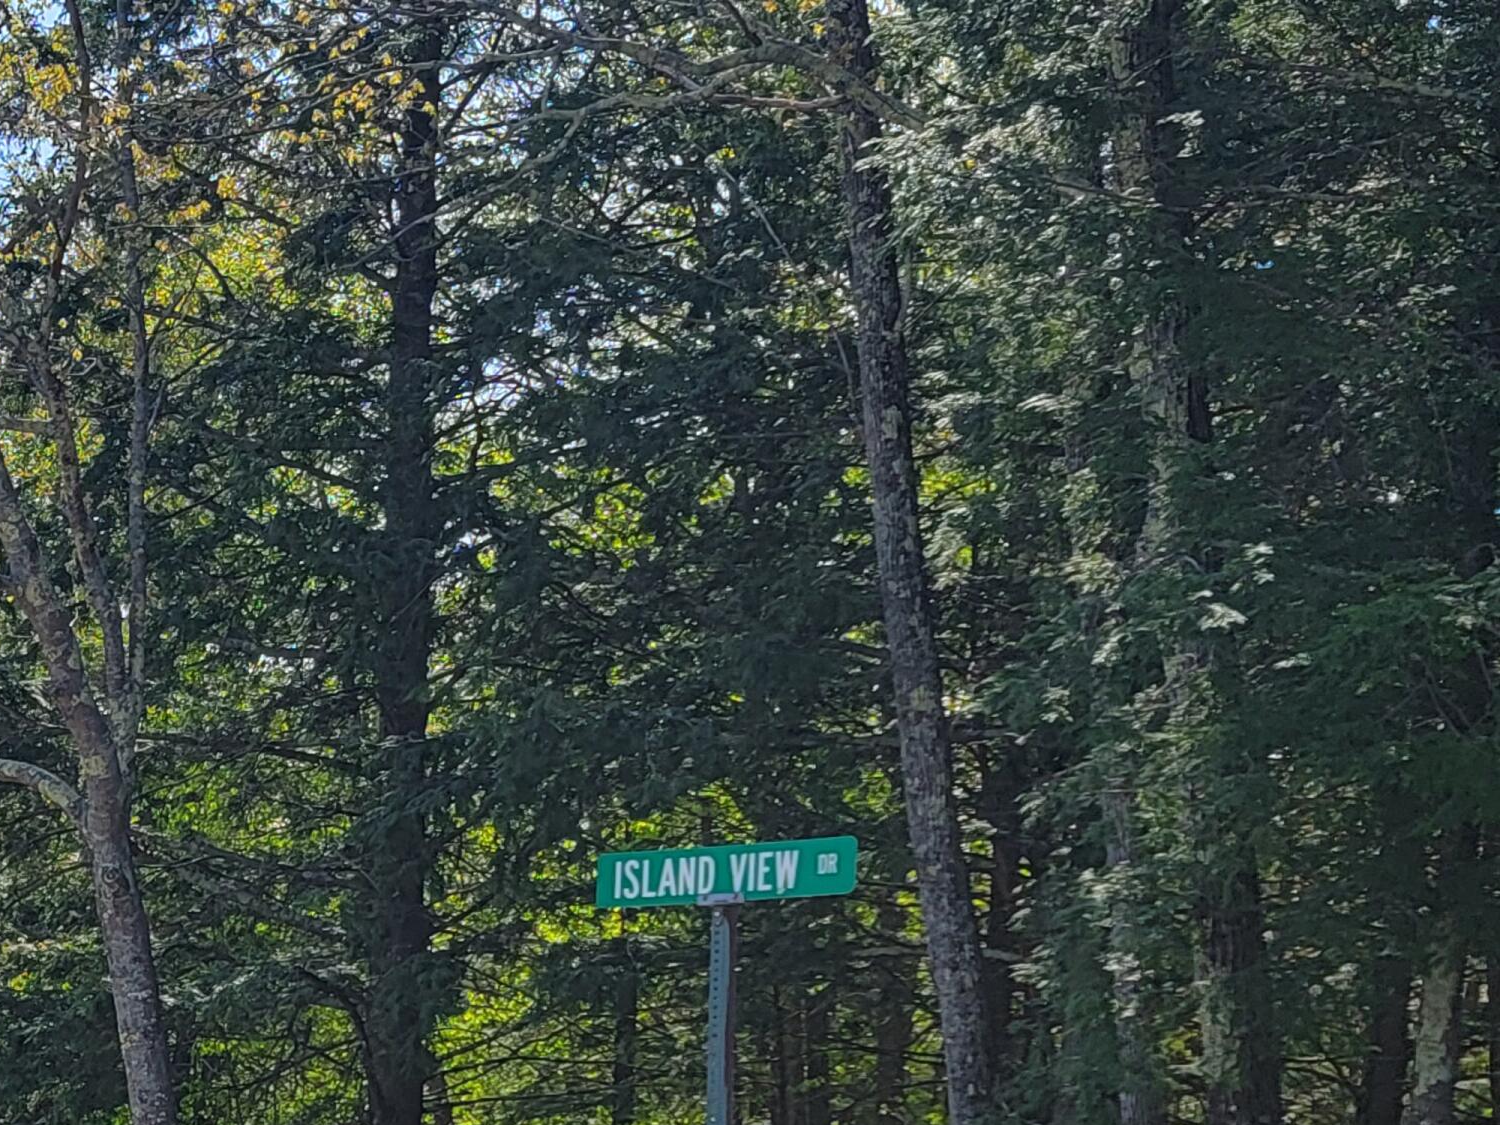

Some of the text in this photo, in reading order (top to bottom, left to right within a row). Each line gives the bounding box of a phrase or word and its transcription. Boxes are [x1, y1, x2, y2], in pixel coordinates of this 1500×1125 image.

[614, 850, 838, 899] ISLAND VIEW DR
